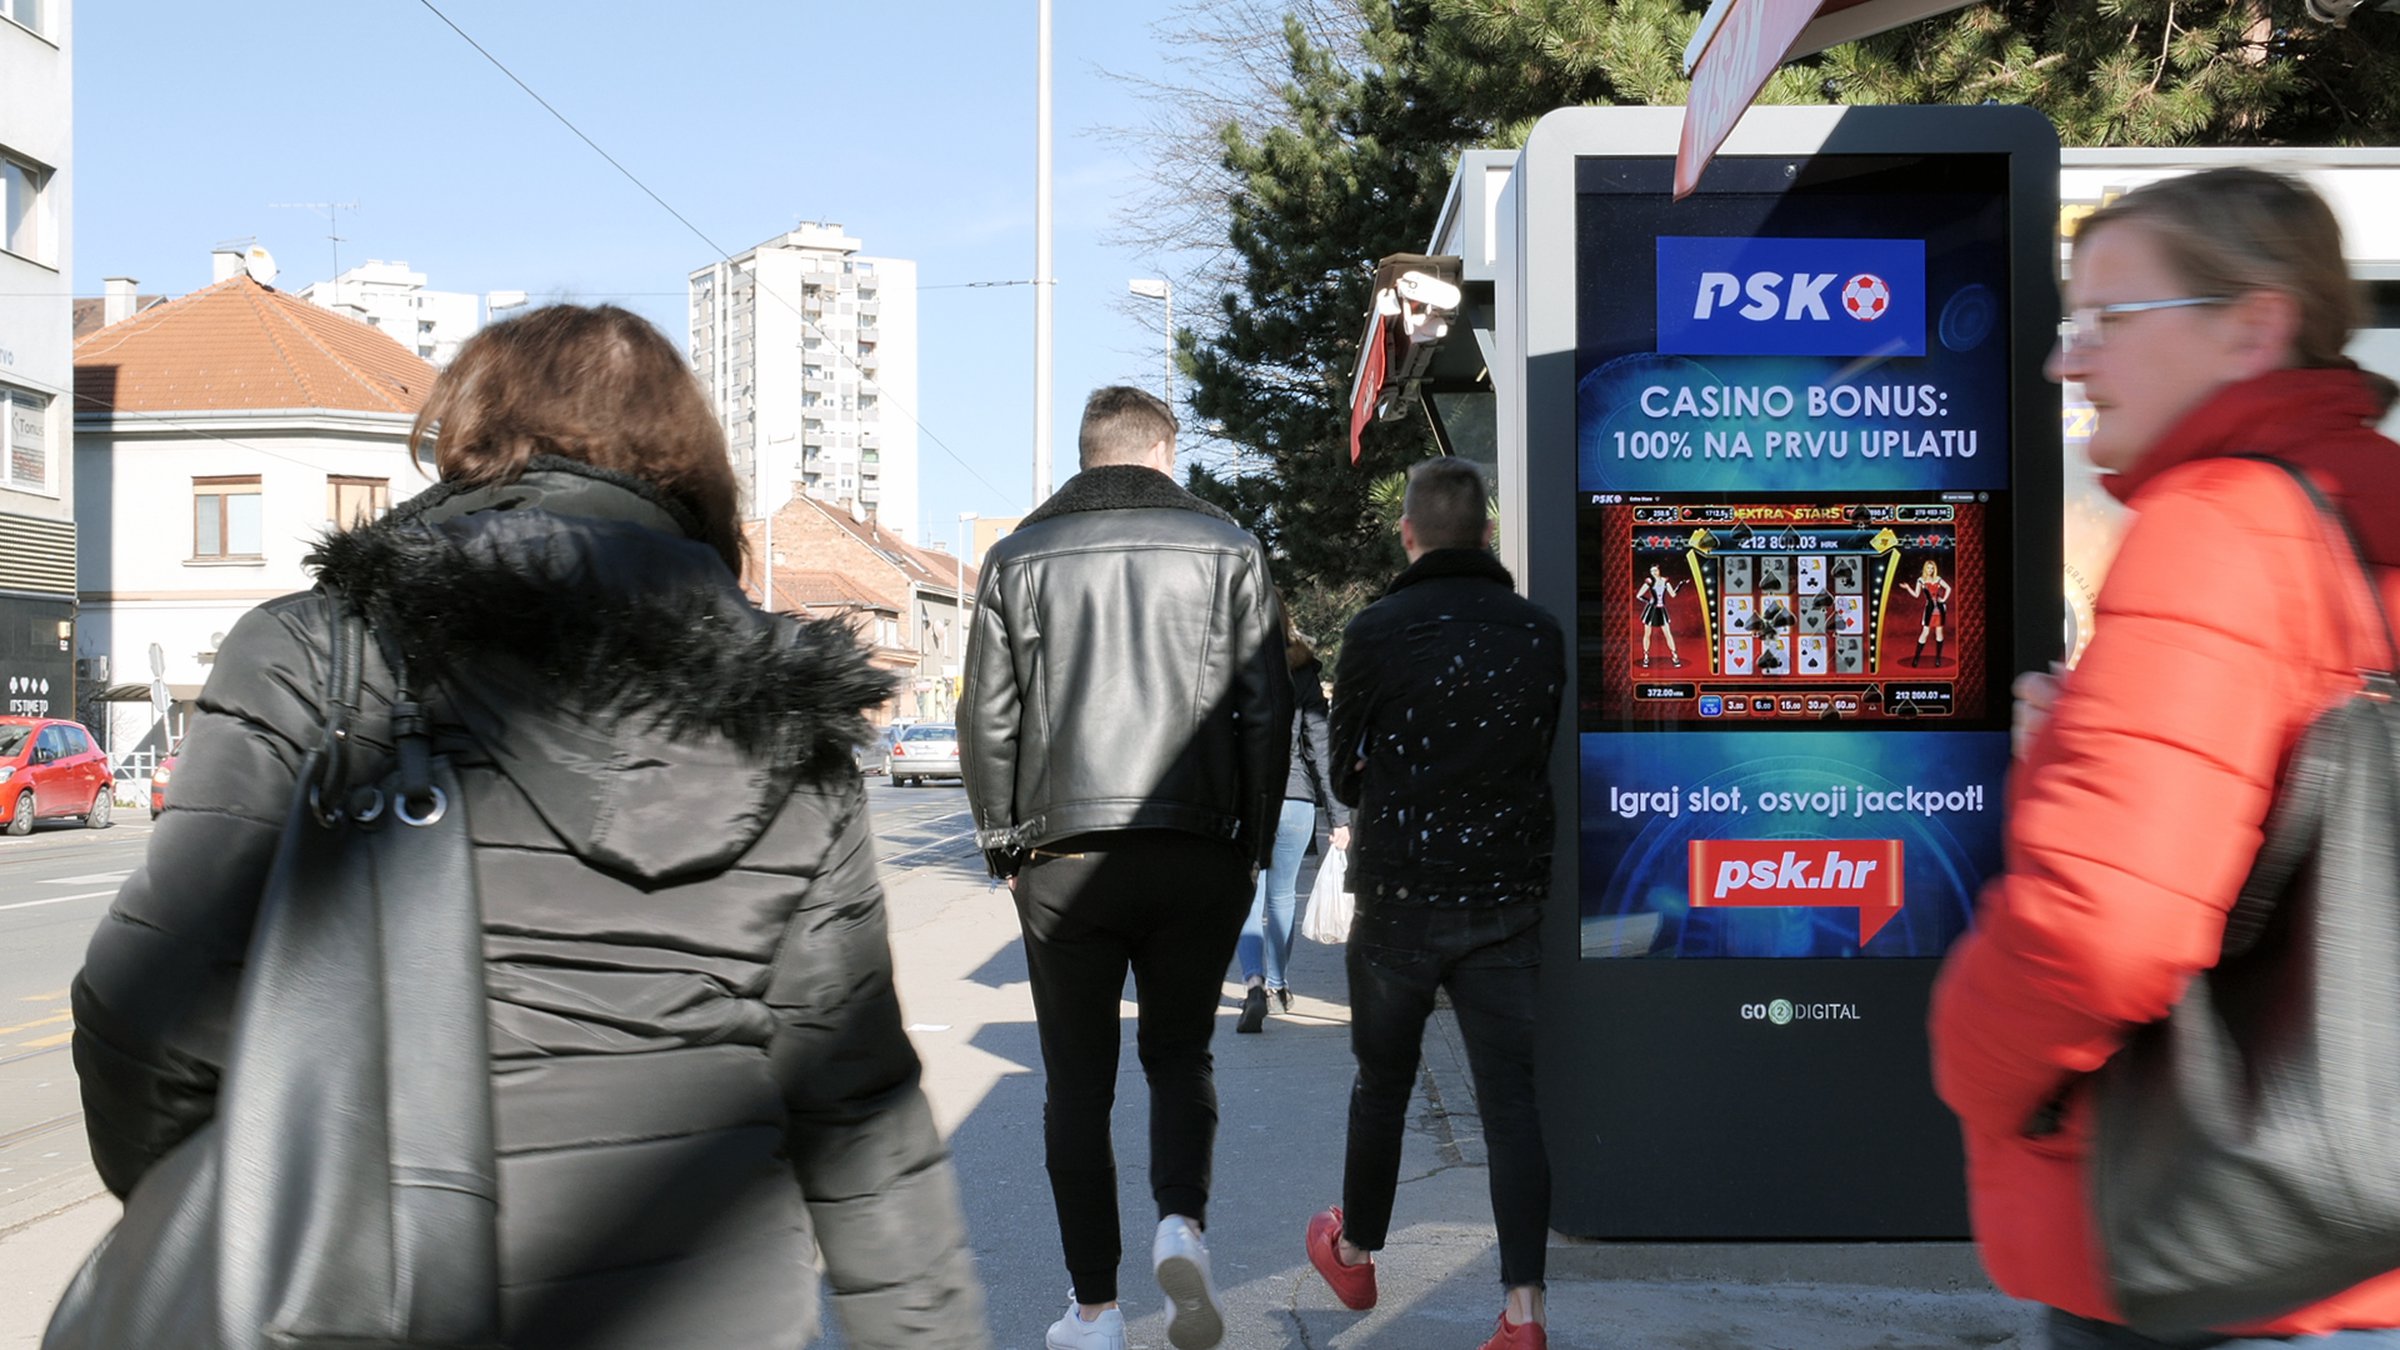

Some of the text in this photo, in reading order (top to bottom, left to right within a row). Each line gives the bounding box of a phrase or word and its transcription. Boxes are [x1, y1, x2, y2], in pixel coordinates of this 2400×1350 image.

[1693, 271, 1838, 321] PSK
[1640, 385, 1948, 418] CASINO BONUS:
[1613, 430, 1977, 459] 100% NA PRVU UPLATU
[1592, 494, 1614, 504] PSK
[1738, 507, 1841, 519] EXTRA STARS
[1610, 784, 1984, 818] Igraj slot, osvoji jackpot!
[1713, 851, 1876, 898] psk.hr
